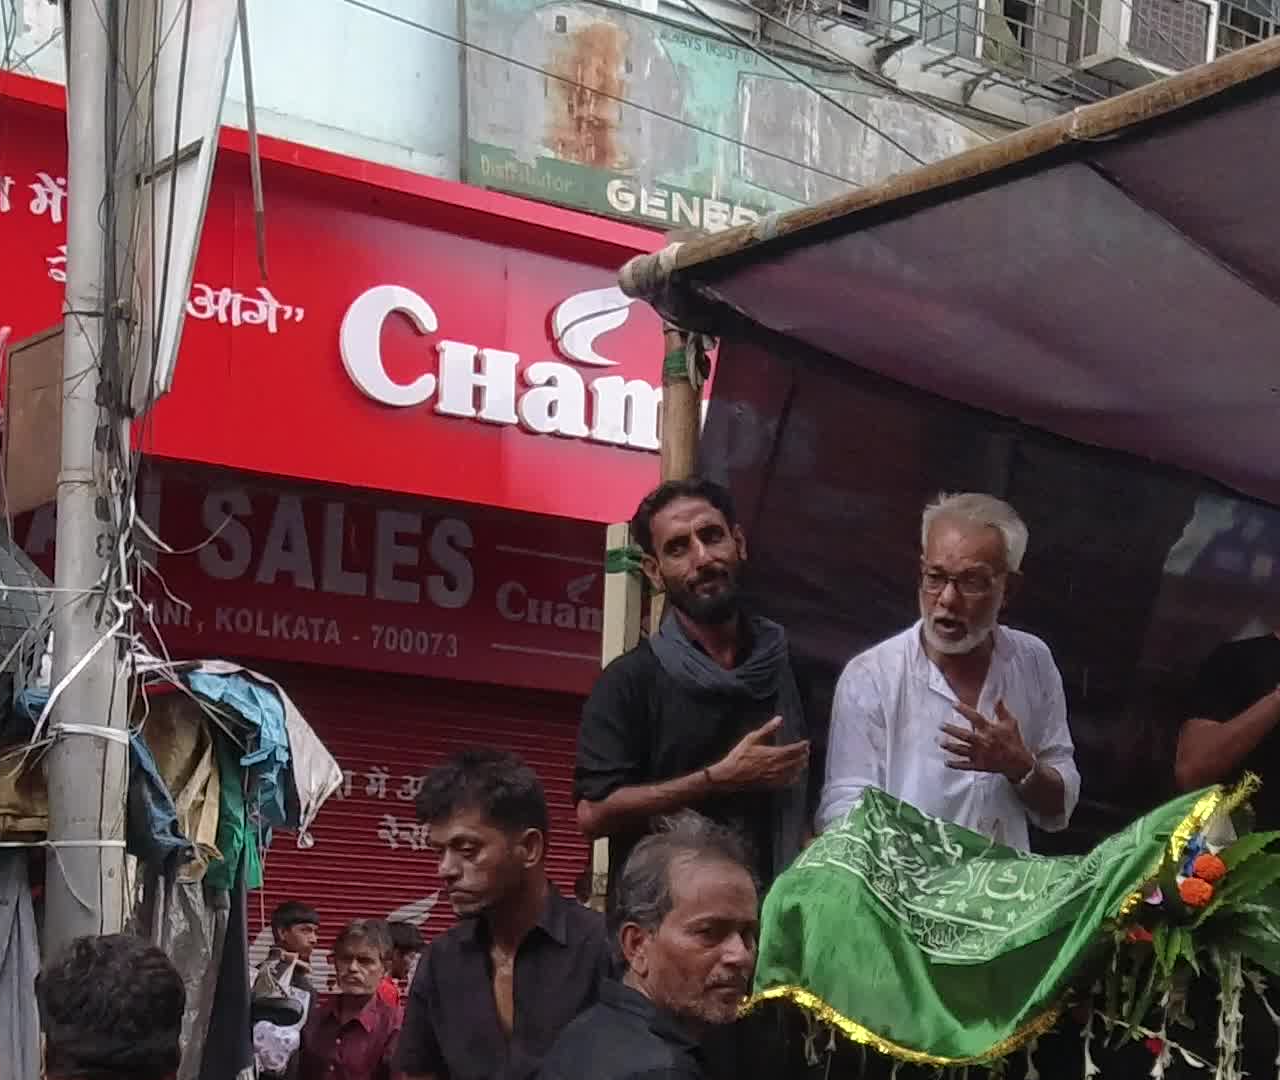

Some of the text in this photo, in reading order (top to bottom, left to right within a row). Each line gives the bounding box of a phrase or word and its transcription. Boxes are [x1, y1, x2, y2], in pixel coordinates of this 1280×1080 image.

[198, 486, 476, 609] SALES
[215, 606, 342, 646] KOLKATA
[371, 624, 459, 658] 700073
